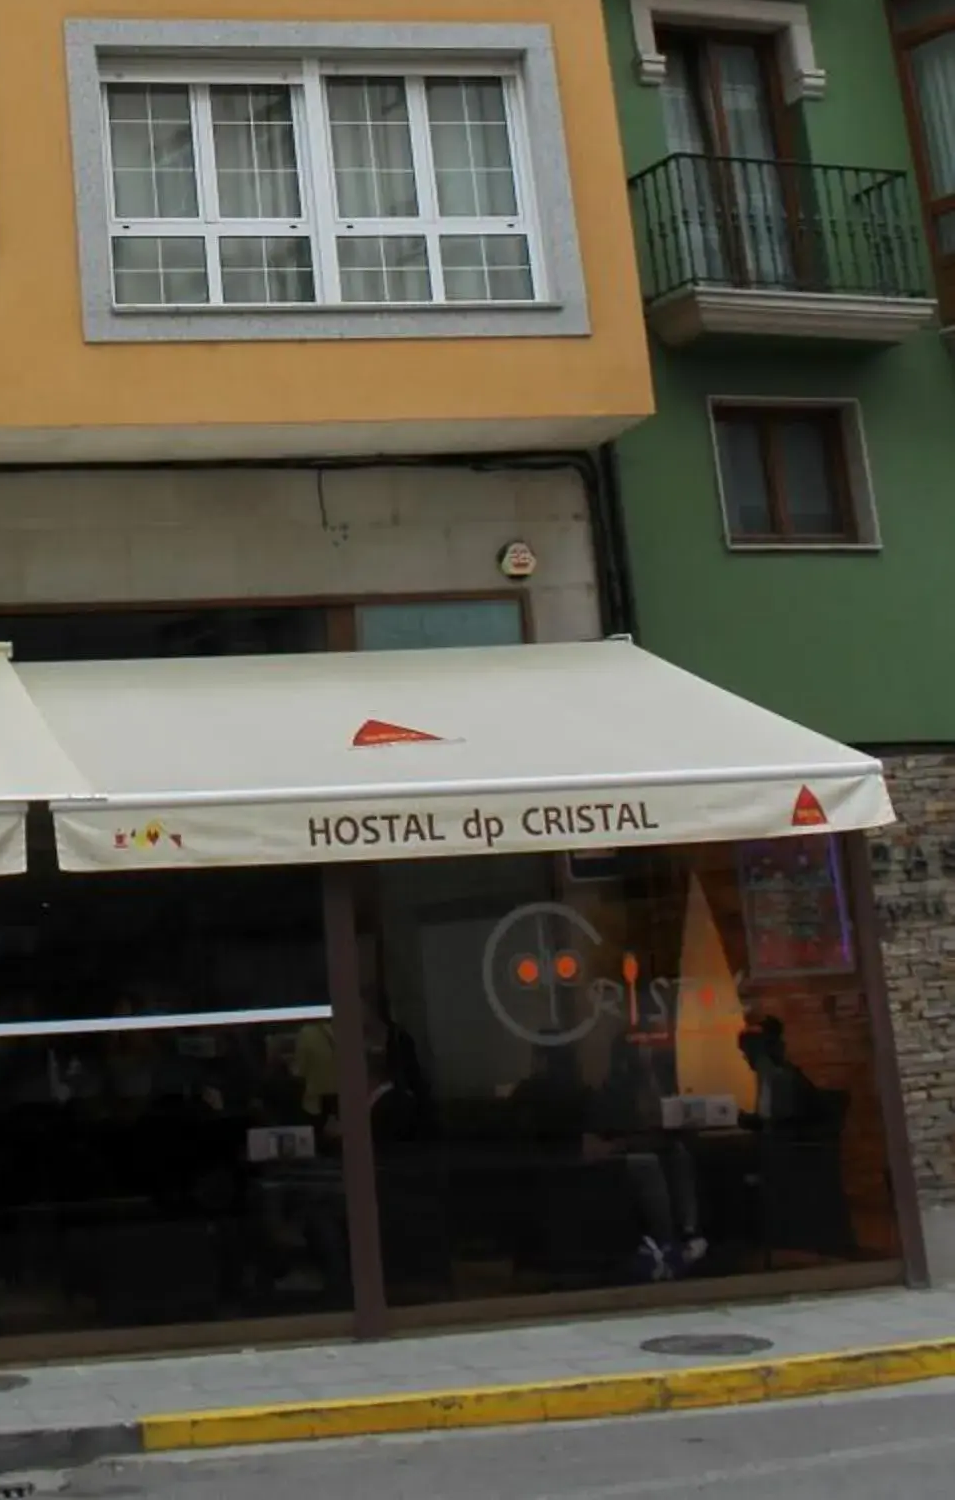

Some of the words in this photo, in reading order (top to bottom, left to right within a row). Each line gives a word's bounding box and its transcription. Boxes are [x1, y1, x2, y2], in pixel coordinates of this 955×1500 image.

[308, 813, 446, 847] HOSTAL
[462, 808, 504, 847] dp
[521, 802, 660, 836] CRISTAL
